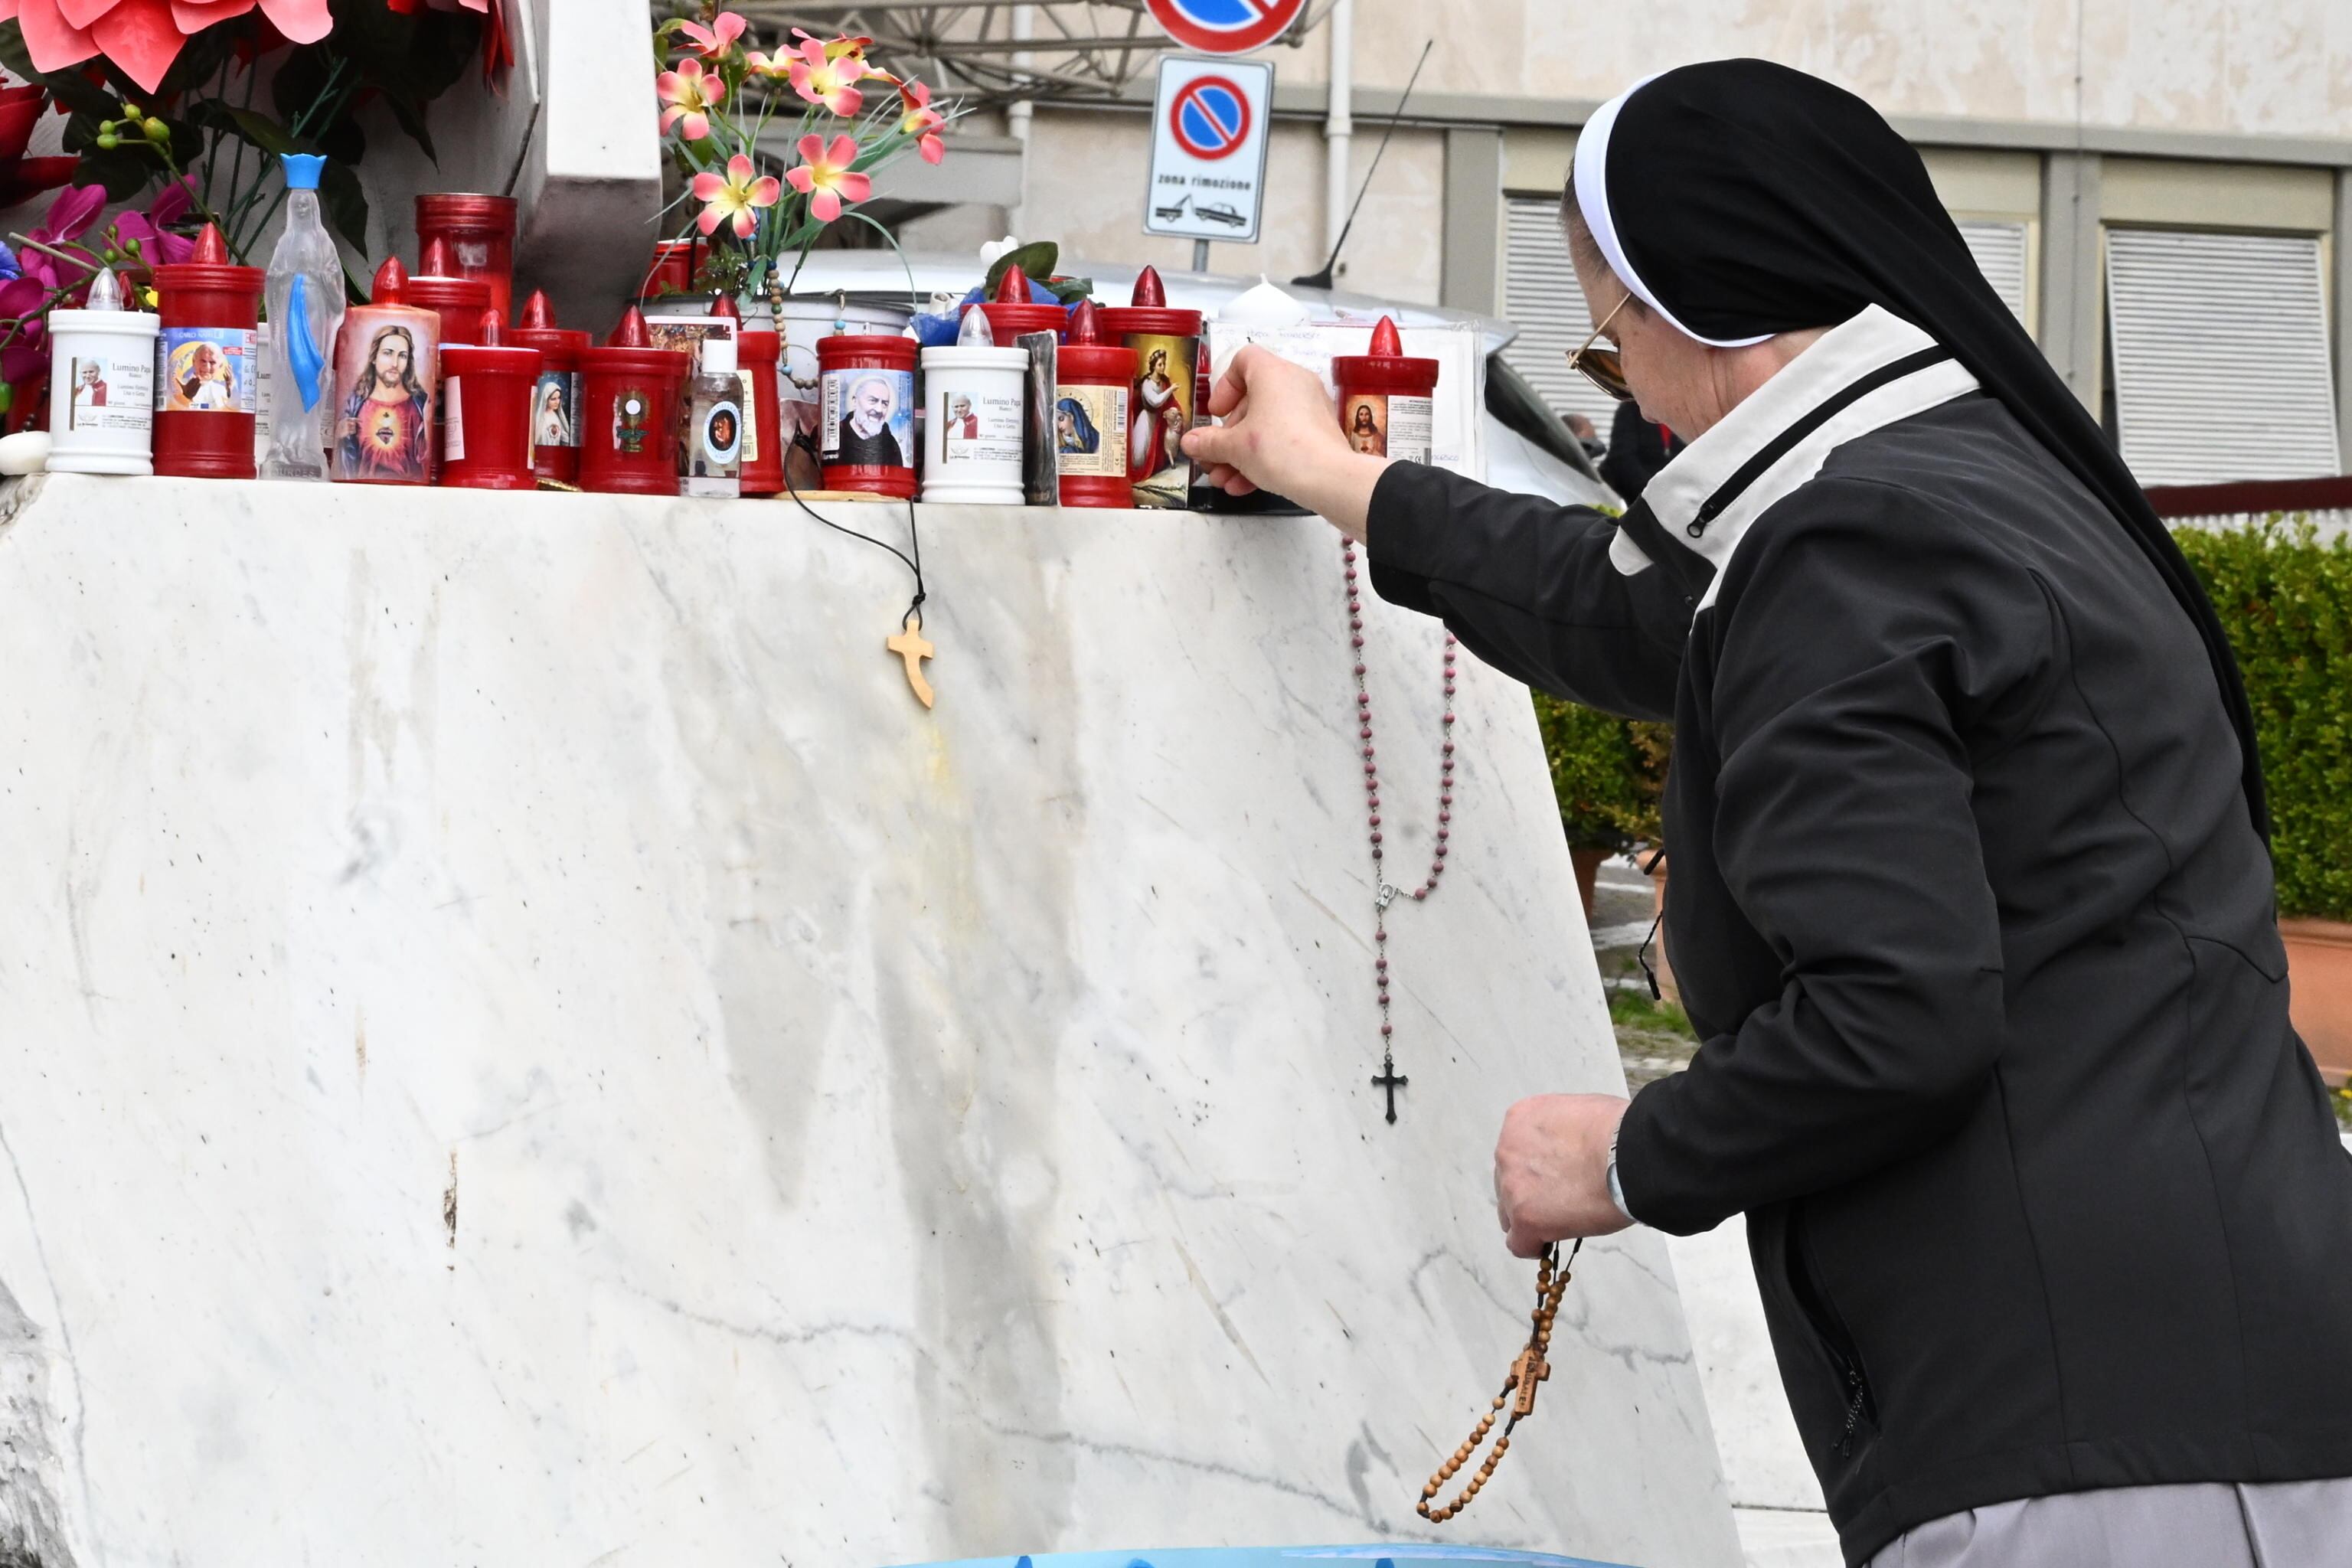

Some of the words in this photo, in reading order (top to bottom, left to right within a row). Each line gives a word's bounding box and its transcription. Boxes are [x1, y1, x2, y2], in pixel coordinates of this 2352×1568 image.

[1158, 174, 1185, 185] zona
[1191, 175, 1251, 191] rimozione
[113, 362, 139, 372] Lumino
[983, 397, 1009, 405] Lumino
[265, 466, 315, 477] OURDES
